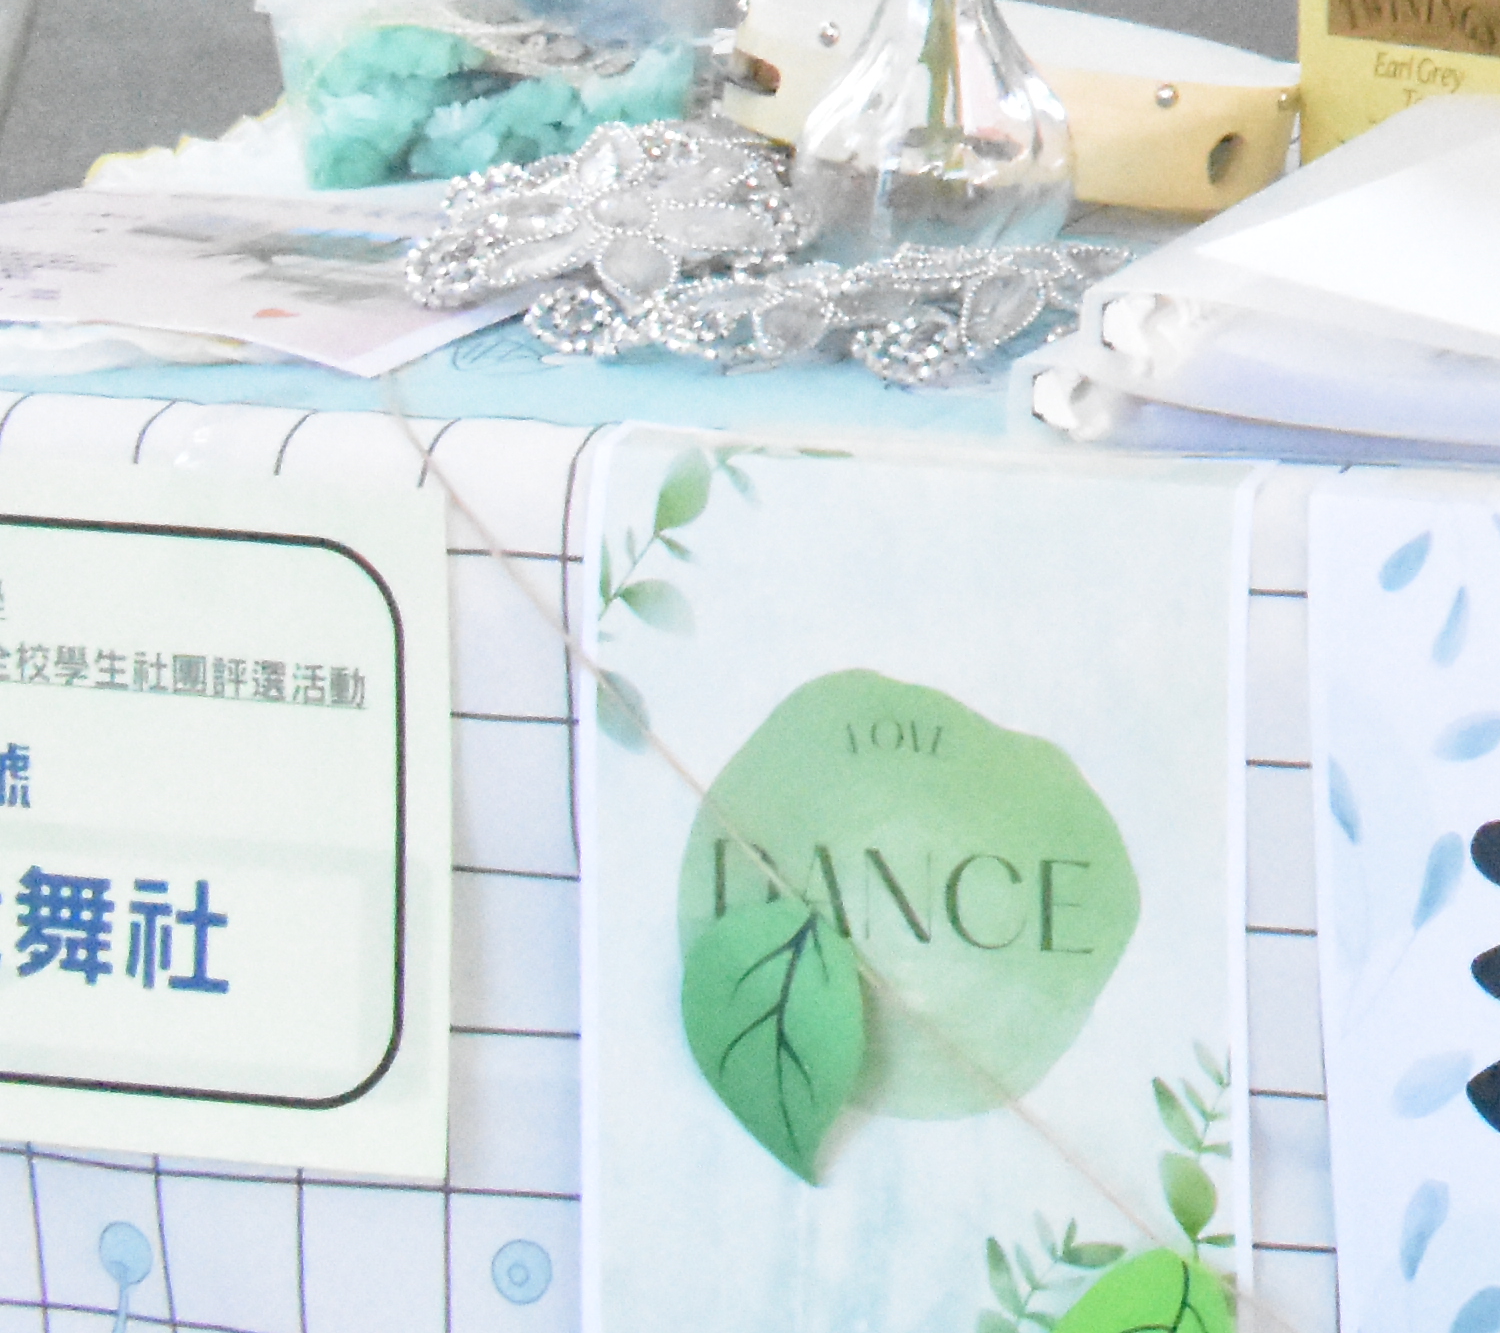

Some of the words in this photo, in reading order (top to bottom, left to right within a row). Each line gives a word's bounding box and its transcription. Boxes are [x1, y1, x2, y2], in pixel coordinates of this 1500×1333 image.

[1374, 51, 1414, 79] Earl
[1417, 57, 1466, 94] Grey
[0, 865, 230, 995] 舞社
[711, 838, 1096, 957] DANCE
